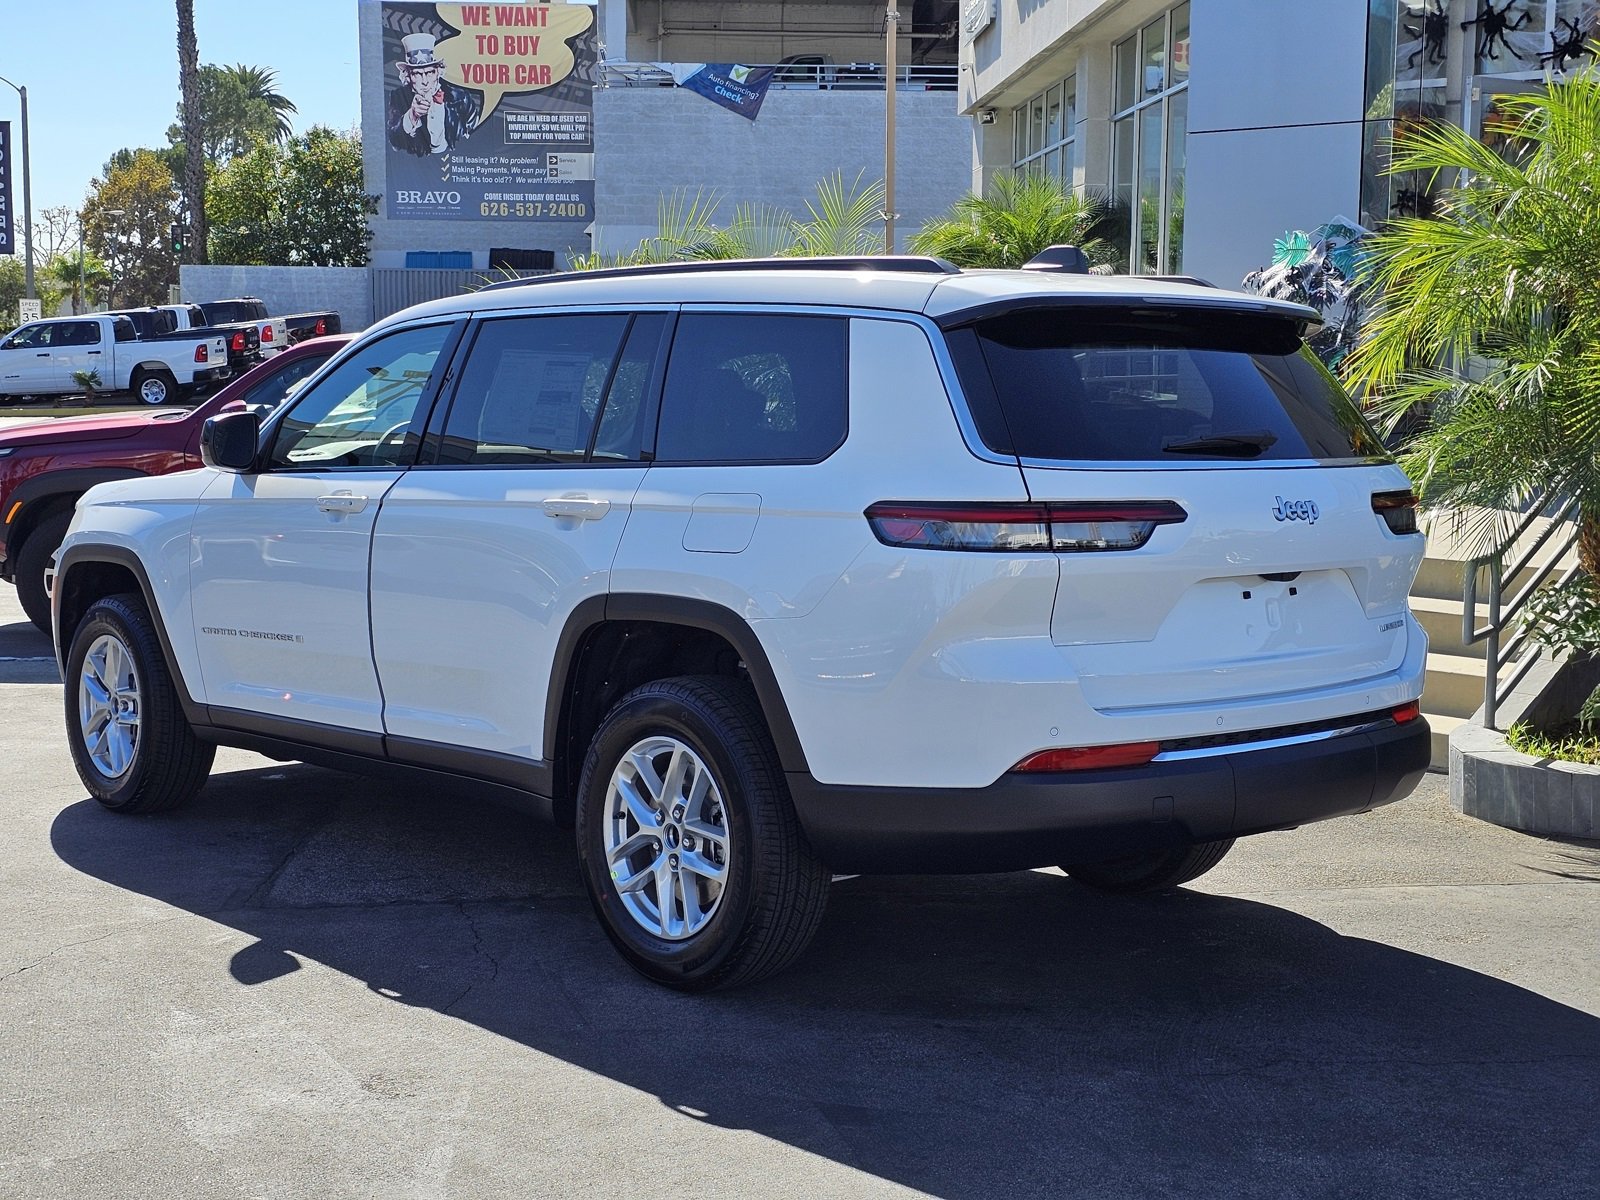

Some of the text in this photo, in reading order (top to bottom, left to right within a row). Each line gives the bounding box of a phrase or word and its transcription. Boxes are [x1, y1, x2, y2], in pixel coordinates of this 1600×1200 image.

[461, 6, 549, 27] WE WANT
[475, 35, 540, 56] TO BUY
[460, 63, 552, 85] YOUR CAR
[708, 73, 759, 100] Auto financing?
[715, 86, 743, 105] Check.
[465, 156, 488, 165] leasing
[510, 157, 538, 166] problem!
[452, 166, 474, 174] Making
[476, 166, 510, 175] Payments,
[396, 190, 461, 204] BRAVO
[480, 202, 586, 216] 626-537-2400
[22, 312, 38, 322] 35
[1272, 496, 1320, 525] Jeep
[201, 626, 236, 636] GRAND
[238, 630, 294, 642] CHEROKEE
